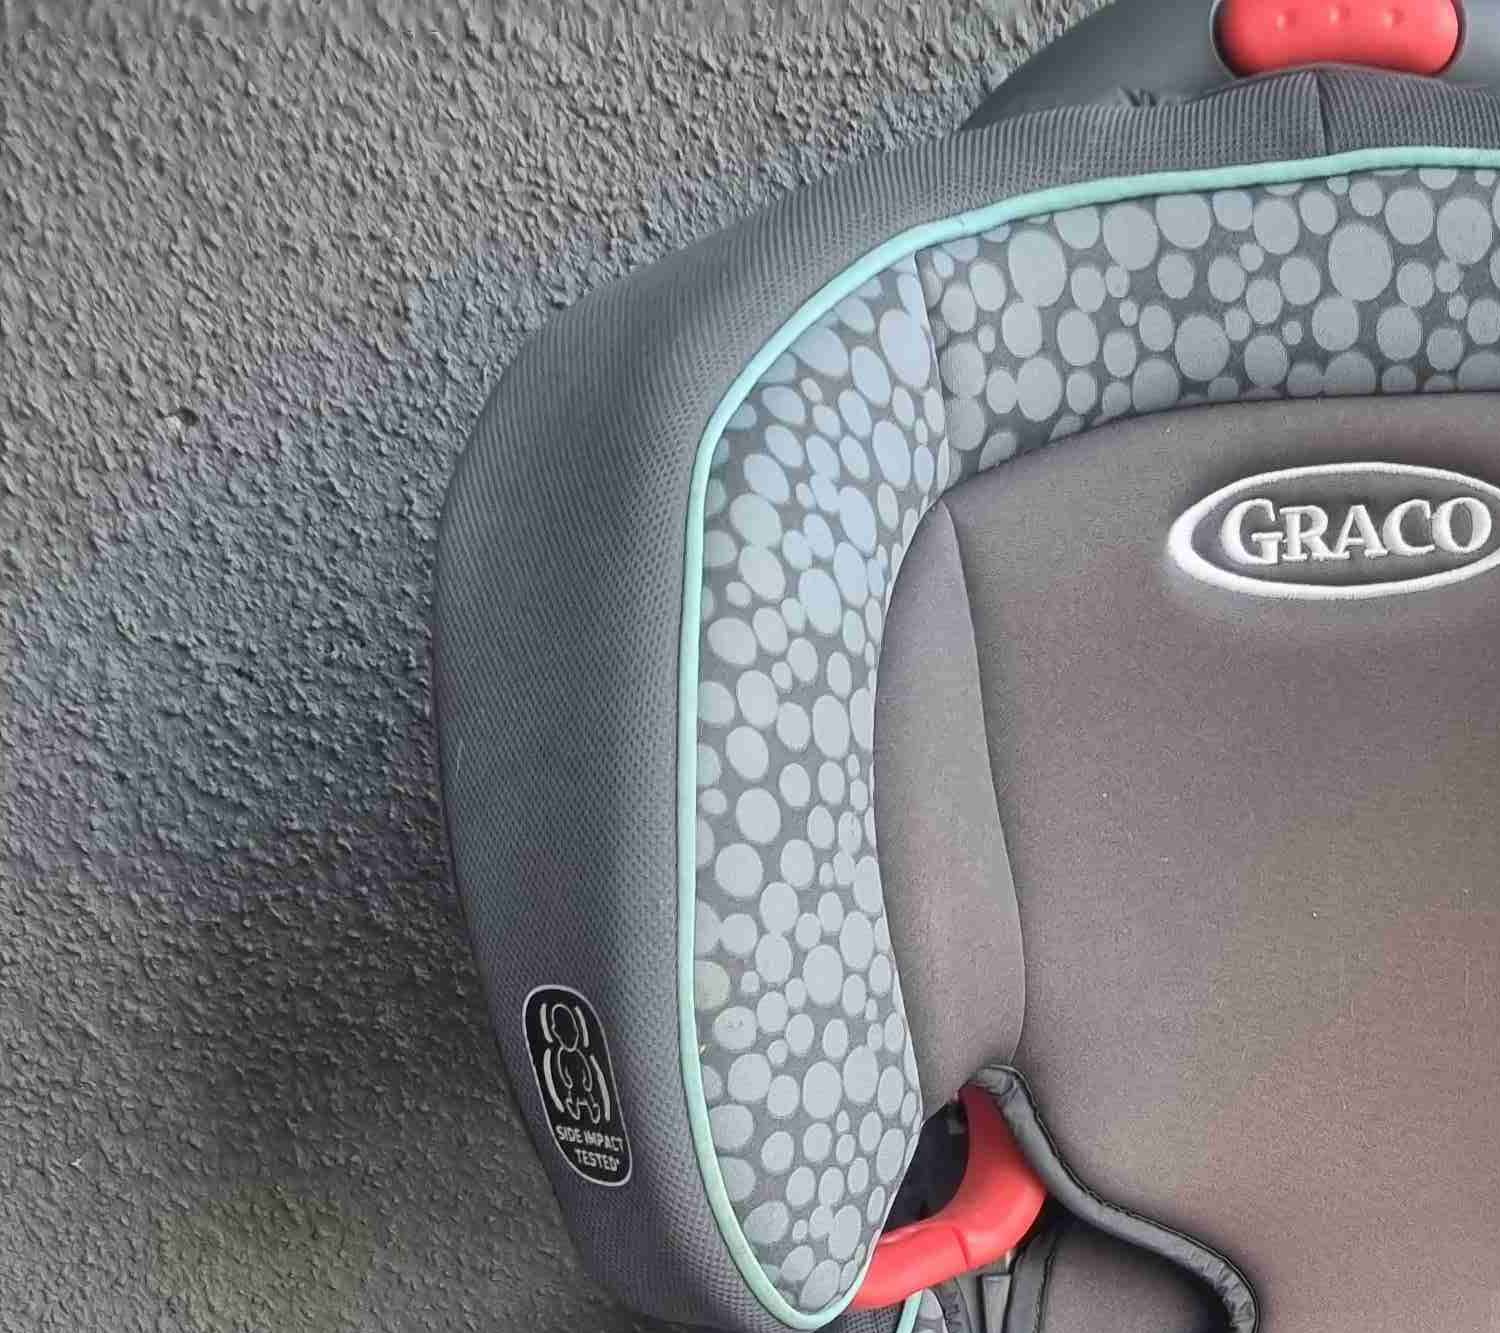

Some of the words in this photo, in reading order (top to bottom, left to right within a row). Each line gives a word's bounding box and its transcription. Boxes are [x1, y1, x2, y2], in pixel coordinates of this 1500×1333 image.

[1220, 497, 1492, 566] GRACO
[555, 1124, 583, 1145] SIDE
[584, 1128, 625, 1151] IMPACT
